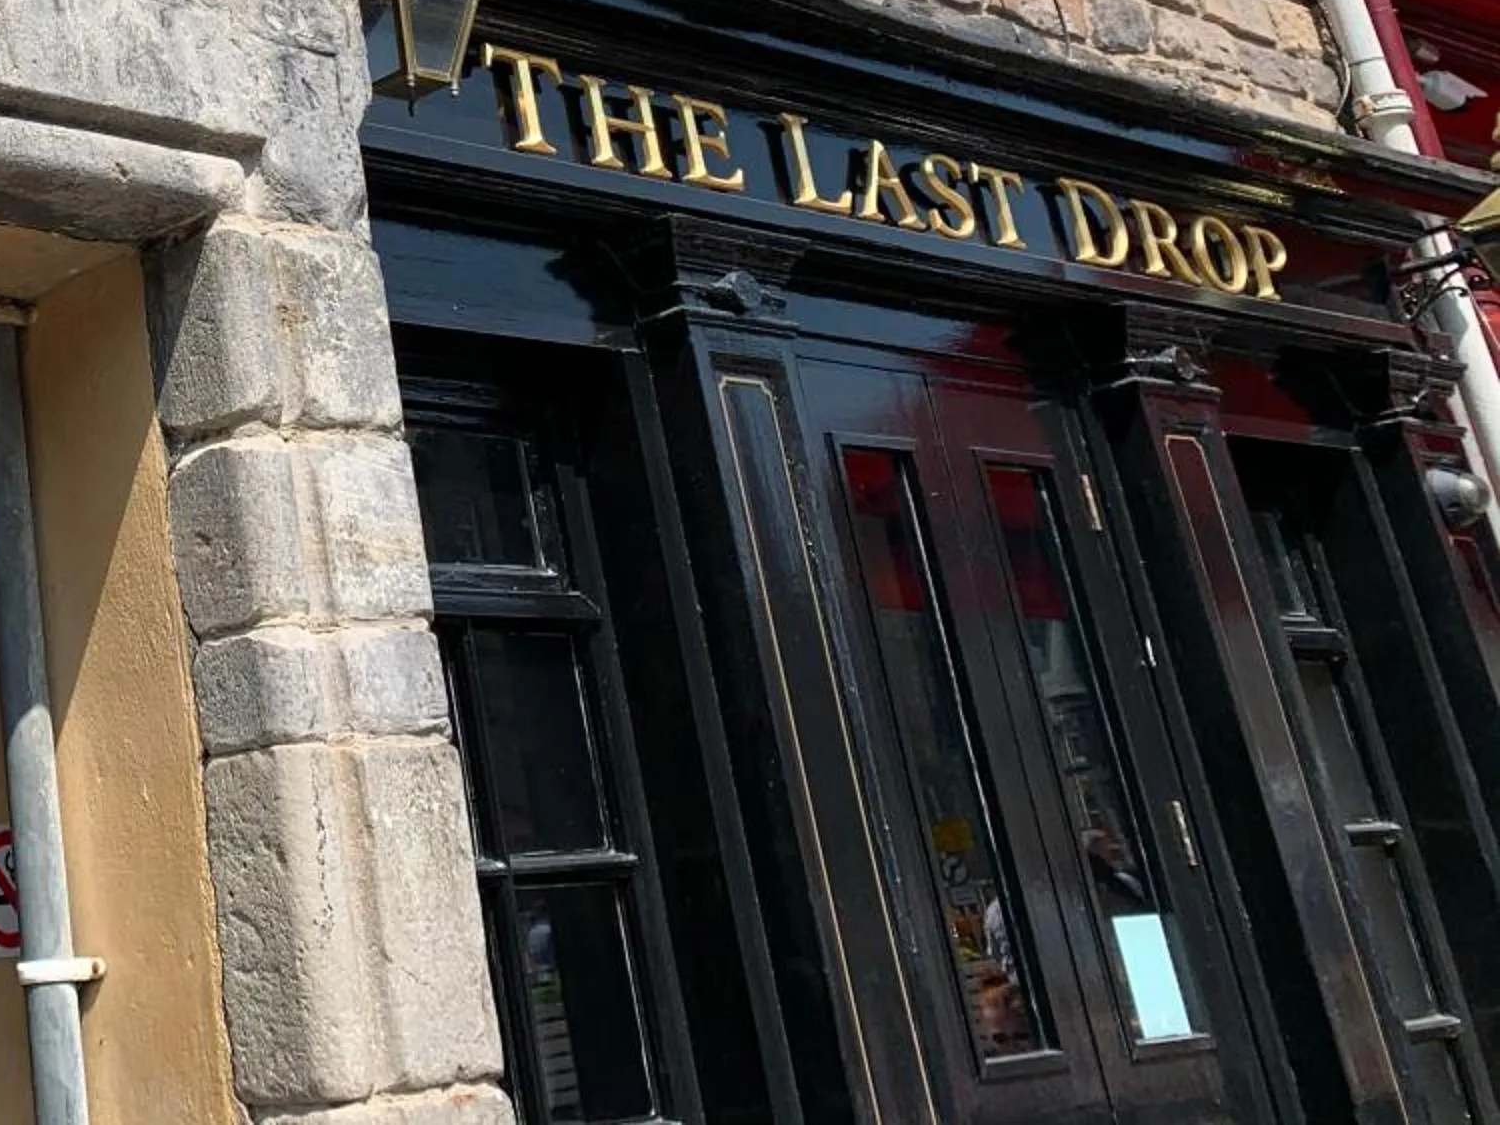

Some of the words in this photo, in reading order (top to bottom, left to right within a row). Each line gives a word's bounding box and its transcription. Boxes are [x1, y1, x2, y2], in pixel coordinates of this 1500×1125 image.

[483, 42, 745, 192] THE
[779, 112, 1027, 250] LAST
[1057, 177, 1287, 301] DROP
